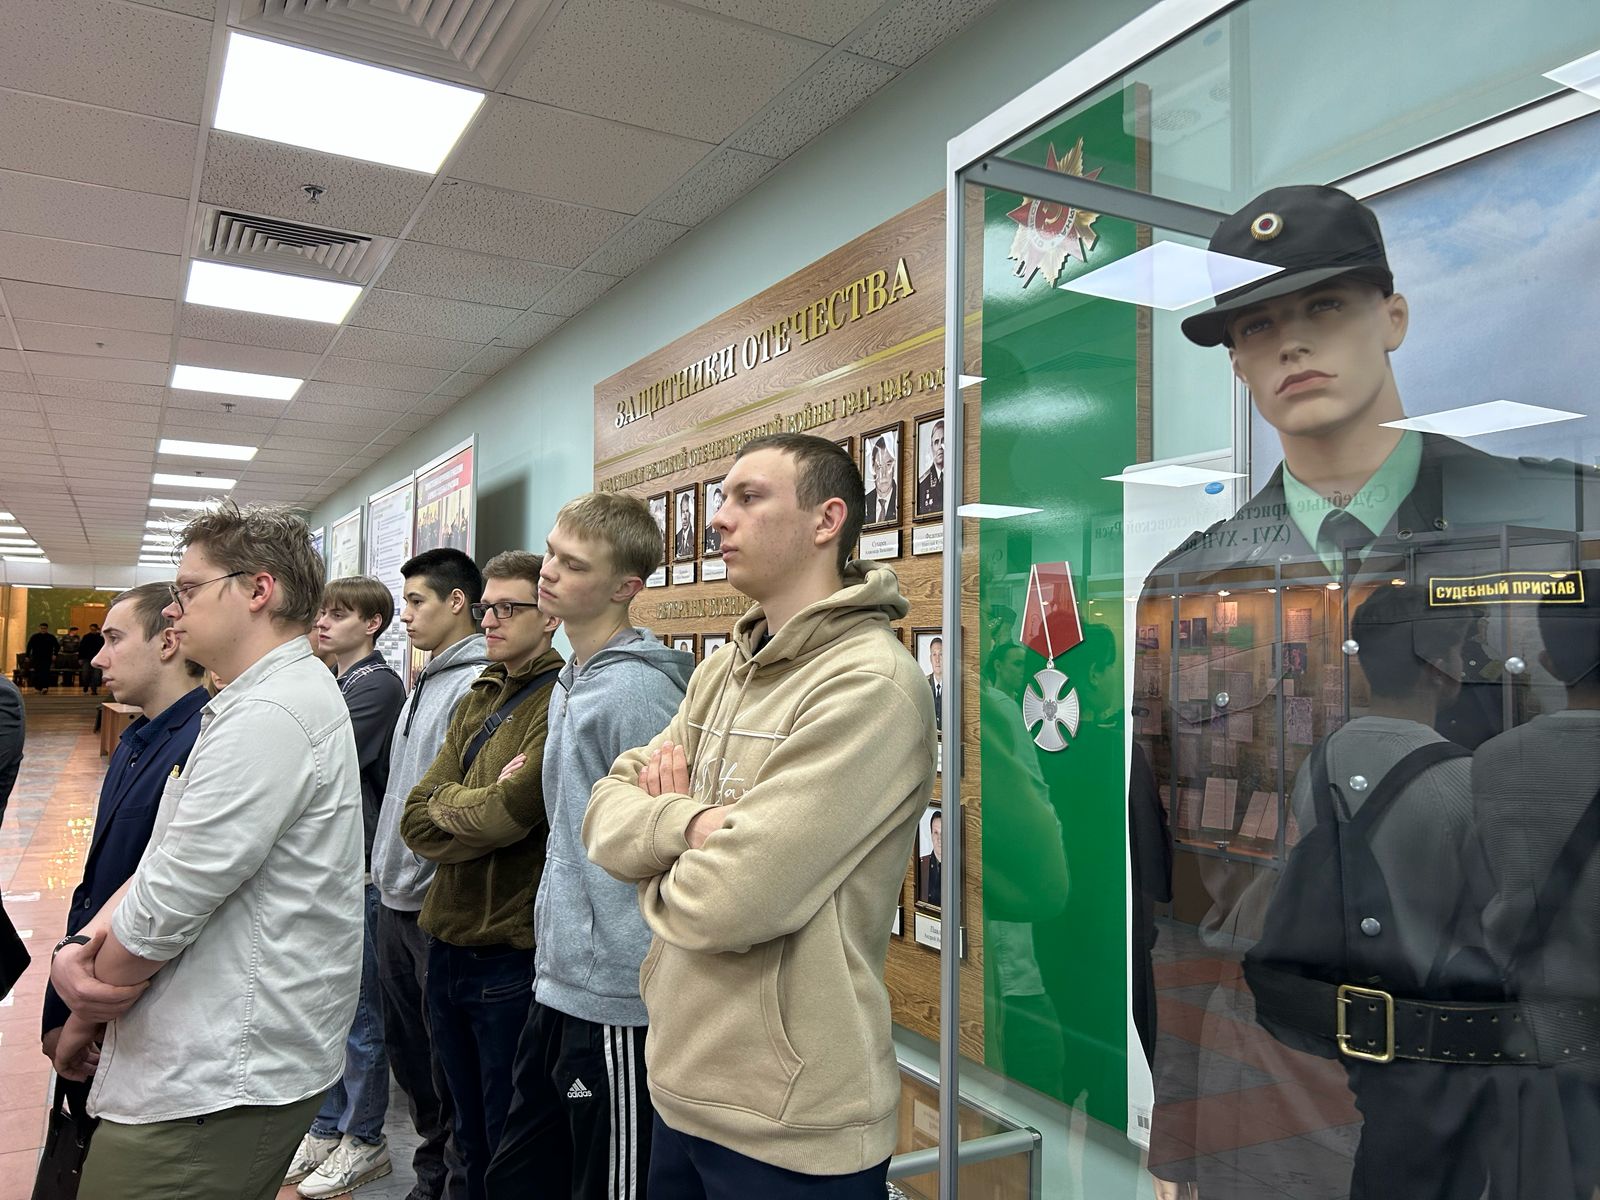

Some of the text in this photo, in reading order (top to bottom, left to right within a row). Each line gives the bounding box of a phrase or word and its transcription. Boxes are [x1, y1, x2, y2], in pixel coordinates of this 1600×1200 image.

[614, 257, 916, 428] ЗАЩИТНИКИ ОТЕЧЕСТВА
[785, 399, 837, 434] ВОЙНЫ
[841, 370, 913, 419] 1941-1945
[918, 367, 945, 392] год
[1436, 580, 1576, 599] СУДЕБНЫЙ ПРИСТАВ
[567, 1090, 593, 1098] adidas
